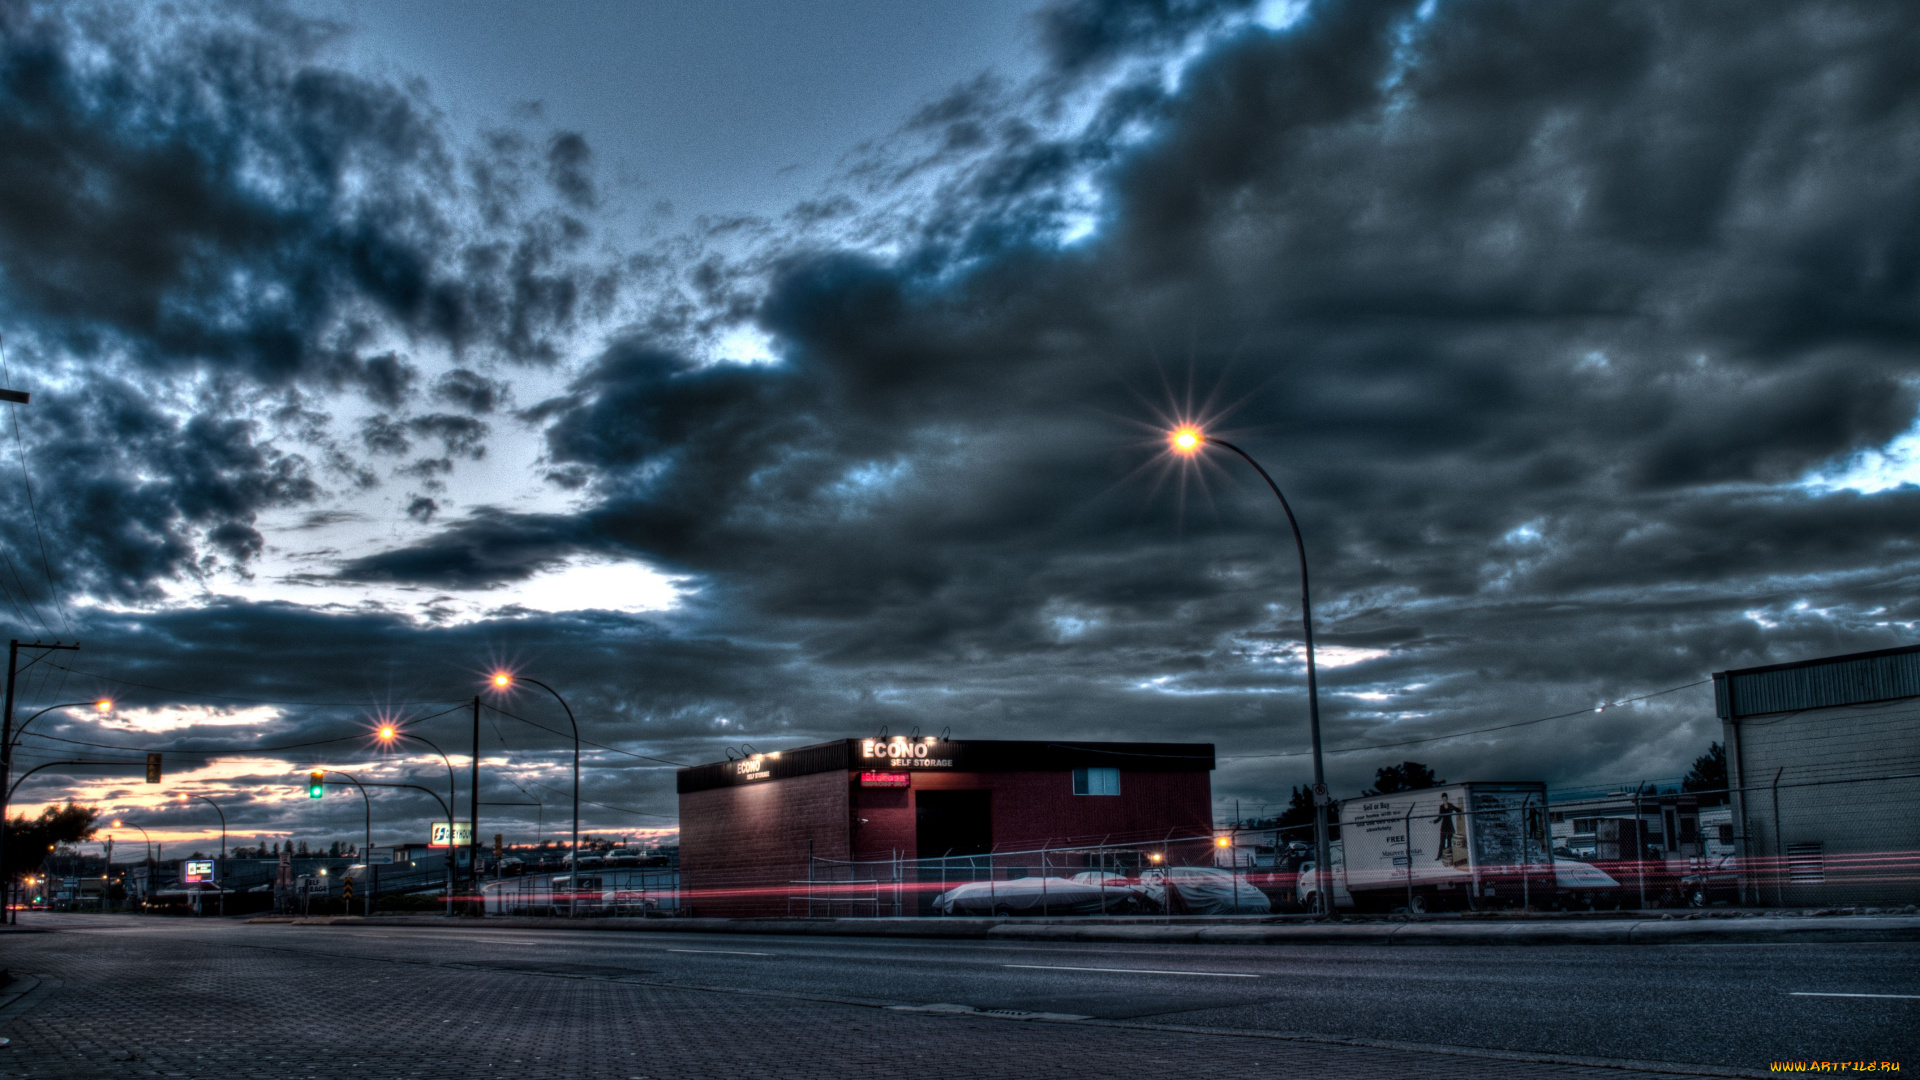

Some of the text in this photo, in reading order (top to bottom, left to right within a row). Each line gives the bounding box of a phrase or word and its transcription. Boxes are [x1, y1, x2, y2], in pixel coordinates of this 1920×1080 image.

[862, 741, 928, 758] ECONO
[891, 759, 953, 767] SELF STORAGE
[737, 760, 761, 775] ECONO
[755, 771, 770, 779] STORAGE
[1363, 803, 1373, 811] Sell
[298, 885, 328, 893] STRAGE
